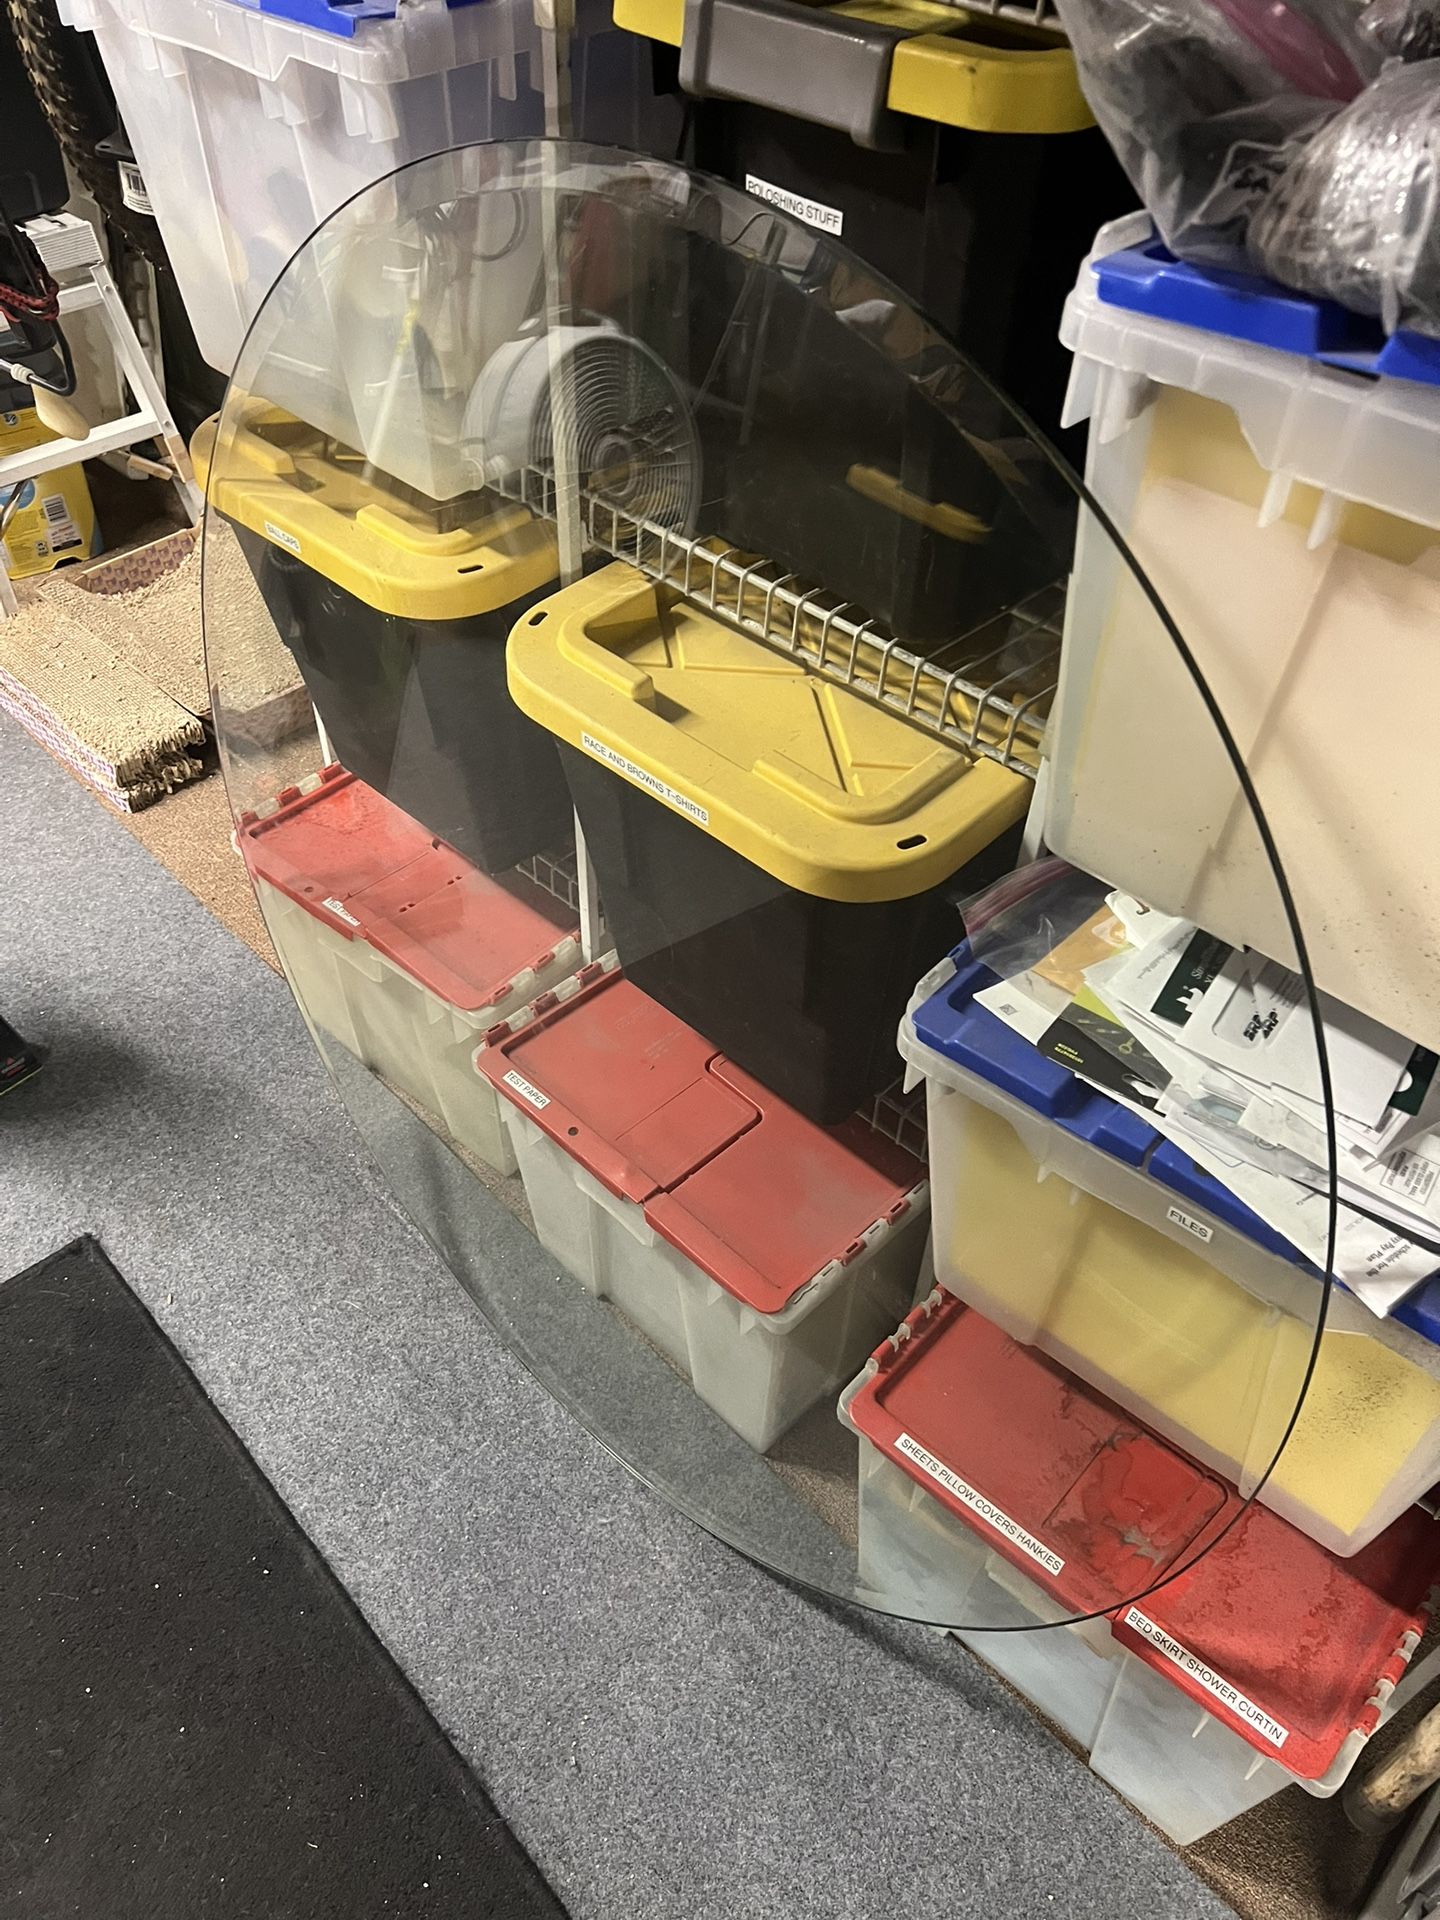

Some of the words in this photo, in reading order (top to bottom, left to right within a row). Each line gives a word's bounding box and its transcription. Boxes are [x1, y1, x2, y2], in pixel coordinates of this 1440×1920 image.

[806, 205, 840, 228] STUFF
[584, 735, 607, 757] RACE
[608, 752, 626, 768] AND
[627, 764, 664, 793] BROWNS
[666, 788, 708, 821] T-SHIRTS
[507, 1072, 526, 1088] TEST
[522, 1085, 547, 1106] PAPER
[1170, 1210, 1208, 1238] FILES
[1366, 1250, 1384, 1262] Plan
[901, 1438, 940, 1472] SHEETS
[938, 1469, 976, 1501] PILLOW
[975, 1499, 1017, 1535] COVERS
[1016, 1531, 1062, 1571] HANKIES
[1128, 1611, 1152, 1634] BED
[1152, 1631, 1188, 1660] SKIRT
[1186, 1658, 1238, 1703] SHOWER
[1238, 1700, 1283, 1739] CURTIN
